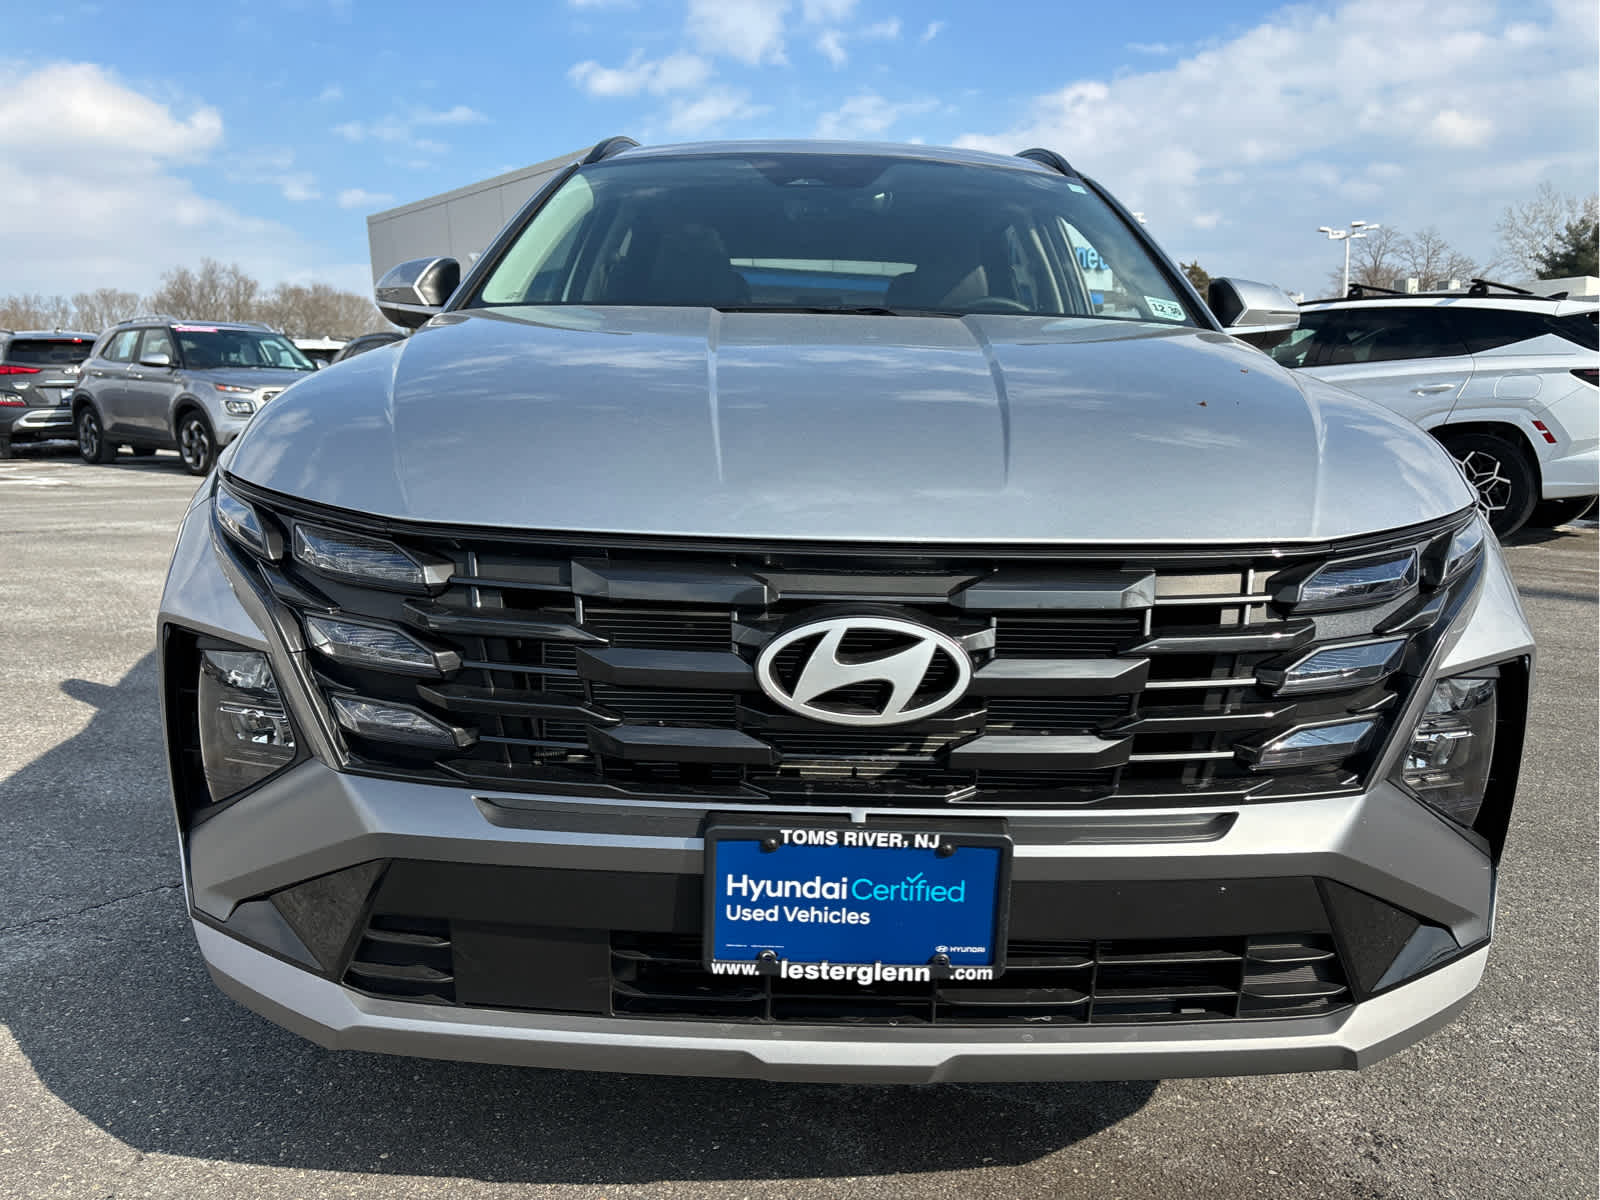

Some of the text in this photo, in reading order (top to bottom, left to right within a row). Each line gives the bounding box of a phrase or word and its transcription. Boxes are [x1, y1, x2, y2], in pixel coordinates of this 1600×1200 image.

[780, 829, 940, 849] TOMS RIVER, NJ
[726, 872, 966, 903] Hyundai Certified
[726, 903, 871, 925] Used Vehicles
[711, 959, 993, 985] www. lesterglenn .com
